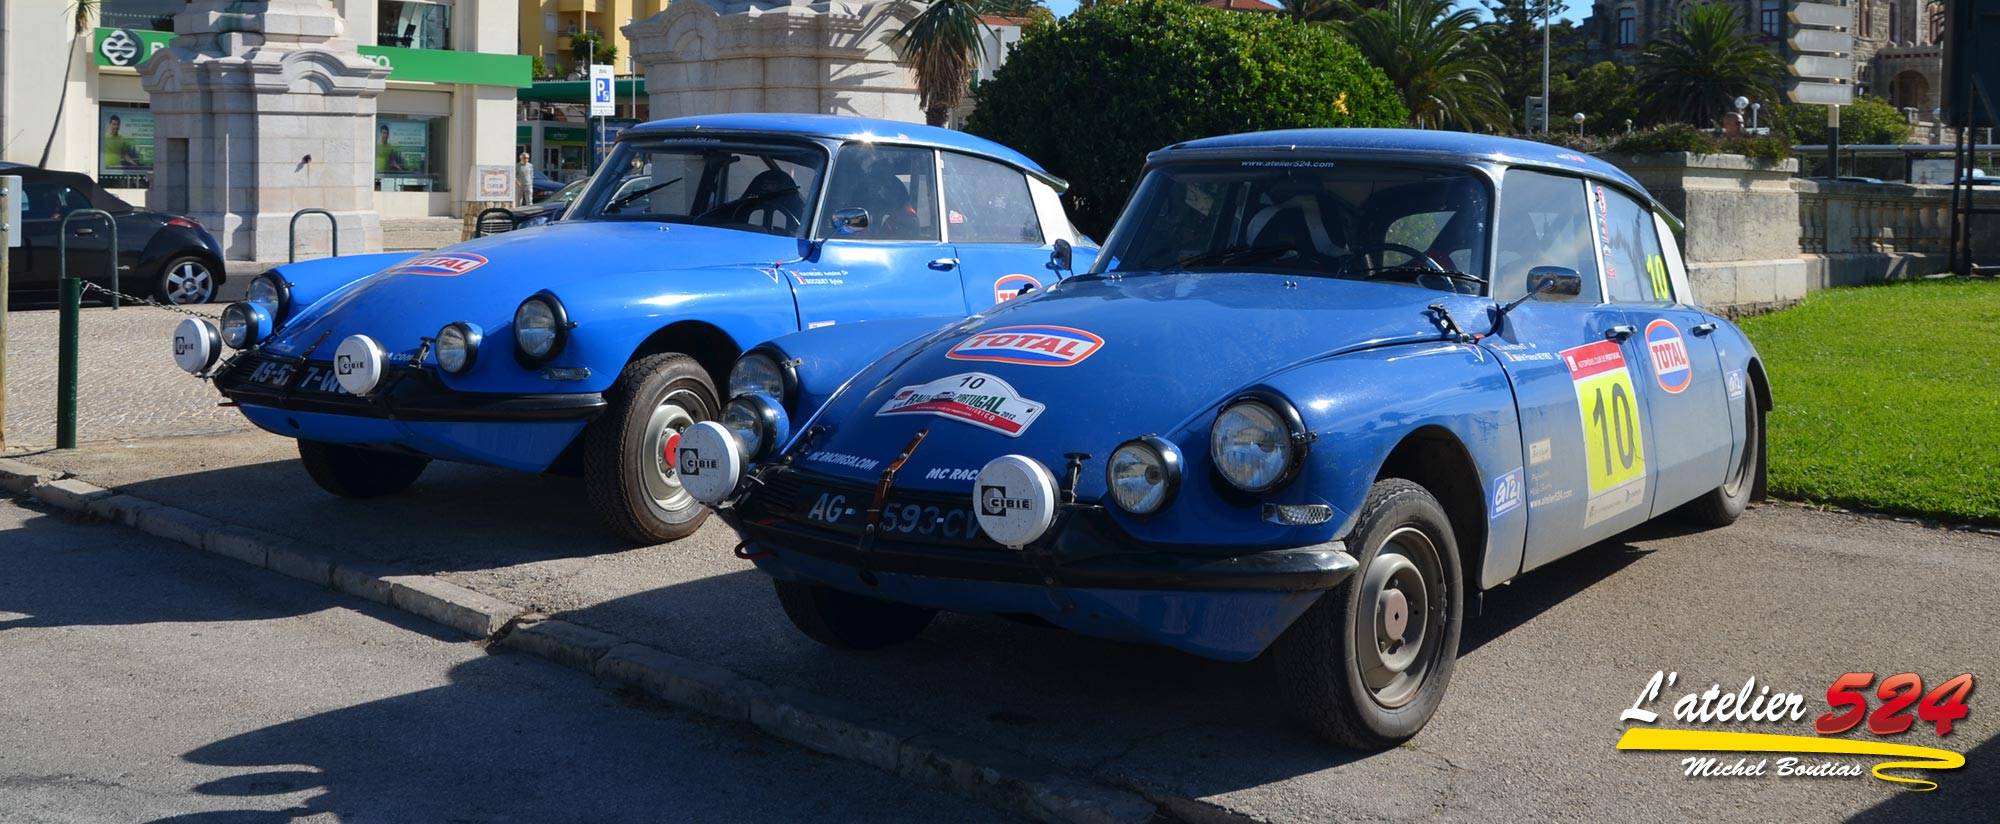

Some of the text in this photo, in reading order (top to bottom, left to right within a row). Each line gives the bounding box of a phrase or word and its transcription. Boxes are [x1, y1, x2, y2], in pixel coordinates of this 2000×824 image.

[1240, 160, 1335, 168] www.atelier524.com
[1646, 254, 1669, 300] 10
[969, 334, 1080, 357] TOTAL
[1651, 341, 1687, 371] TOTAL
[343, 361, 364, 369] CIBIE
[959, 375, 987, 390] 10
[1592, 382, 1635, 476] 10
[687, 459, 718, 469] CIBIE
[926, 467, 951, 480] MC
[807, 492, 857, 524] AG-
[990, 498, 1031, 509] CIBIE
